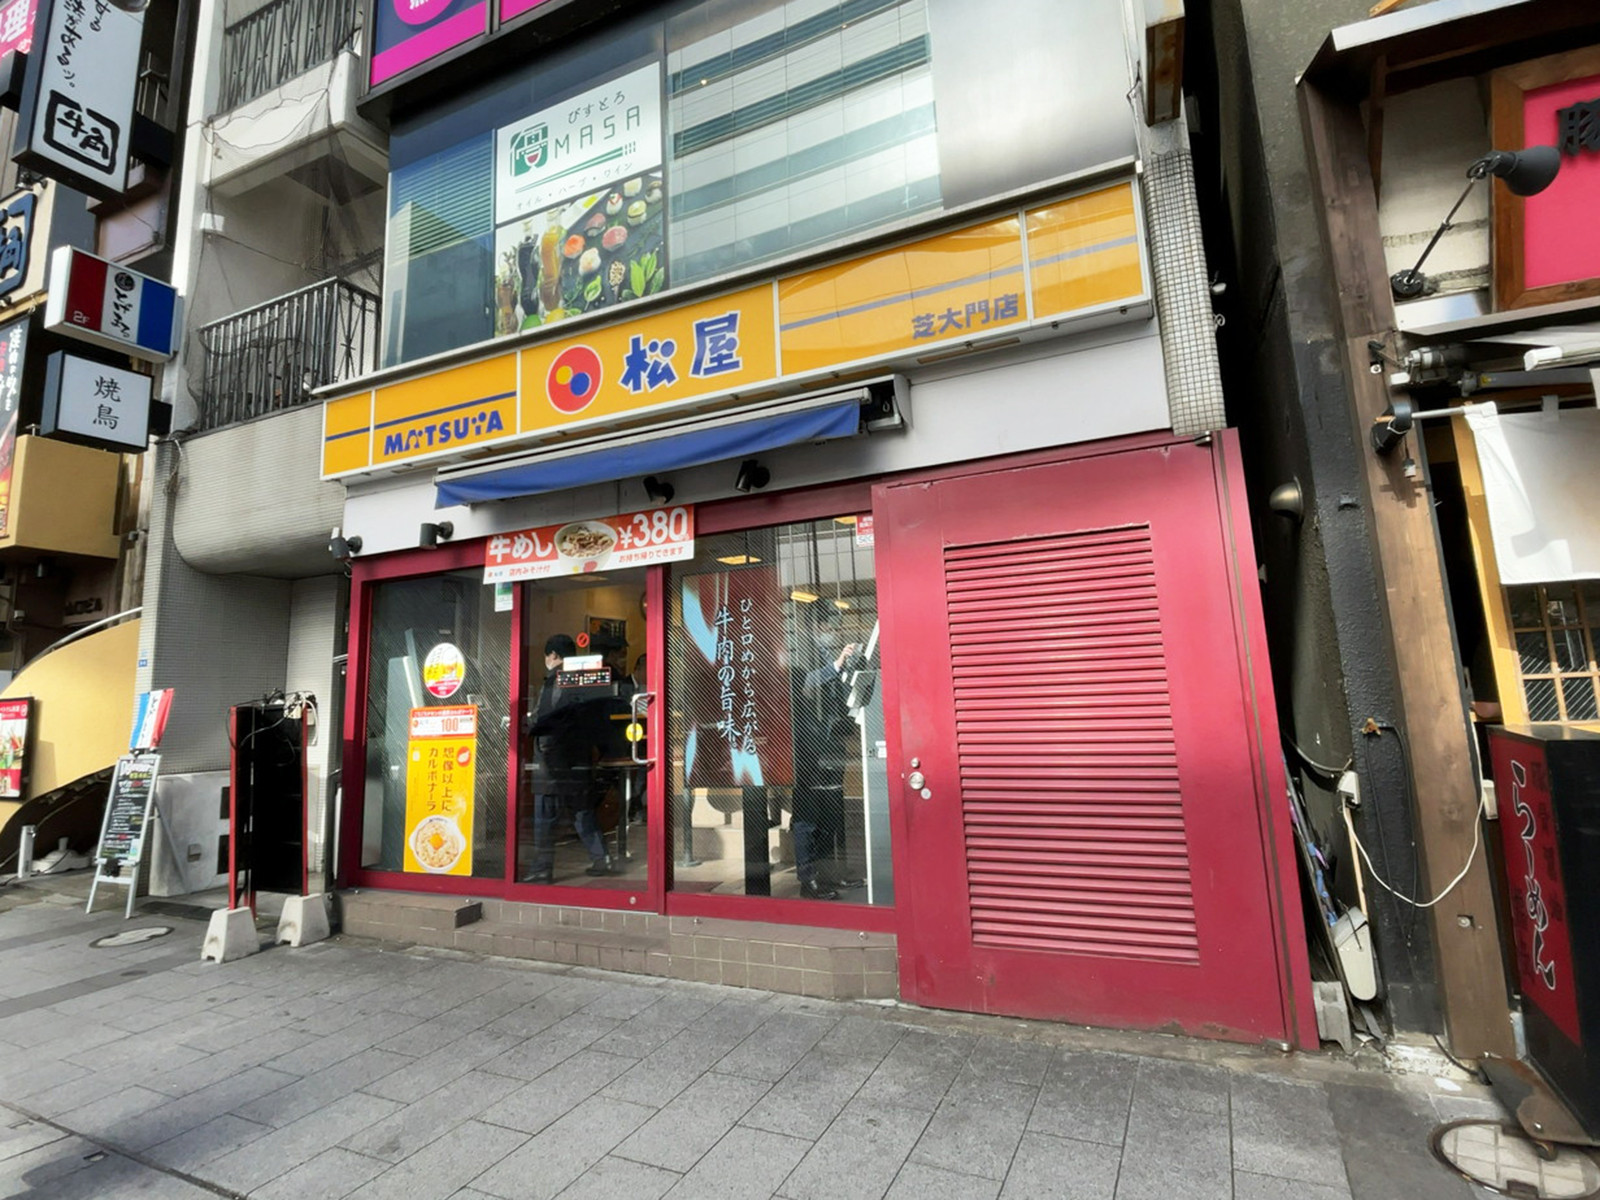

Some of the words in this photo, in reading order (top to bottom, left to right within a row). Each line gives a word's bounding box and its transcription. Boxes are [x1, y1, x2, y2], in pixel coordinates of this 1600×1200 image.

[56, 108, 110, 160] 牛角
[554, 105, 641, 160] MASA
[568, 91, 626, 125] びすとろ
[912, 294, 1018, 339] 芝大門店
[620, 312, 741, 394] 松屋
[93, 375, 122, 430] 焼鳥
[383, 409, 504, 456] MATSUYA
[489, 531, 554, 563] 牛めし
[618, 506, 688, 549] ¥380
[618, 546, 685, 564] お持ち帰りできます
[740, 598, 758, 755] ひと口めから広がる
[426, 747, 439, 812] カルボナーラ
[441, 747, 455, 812] 想像以上に
[1510, 759, 1557, 991] らーめん
